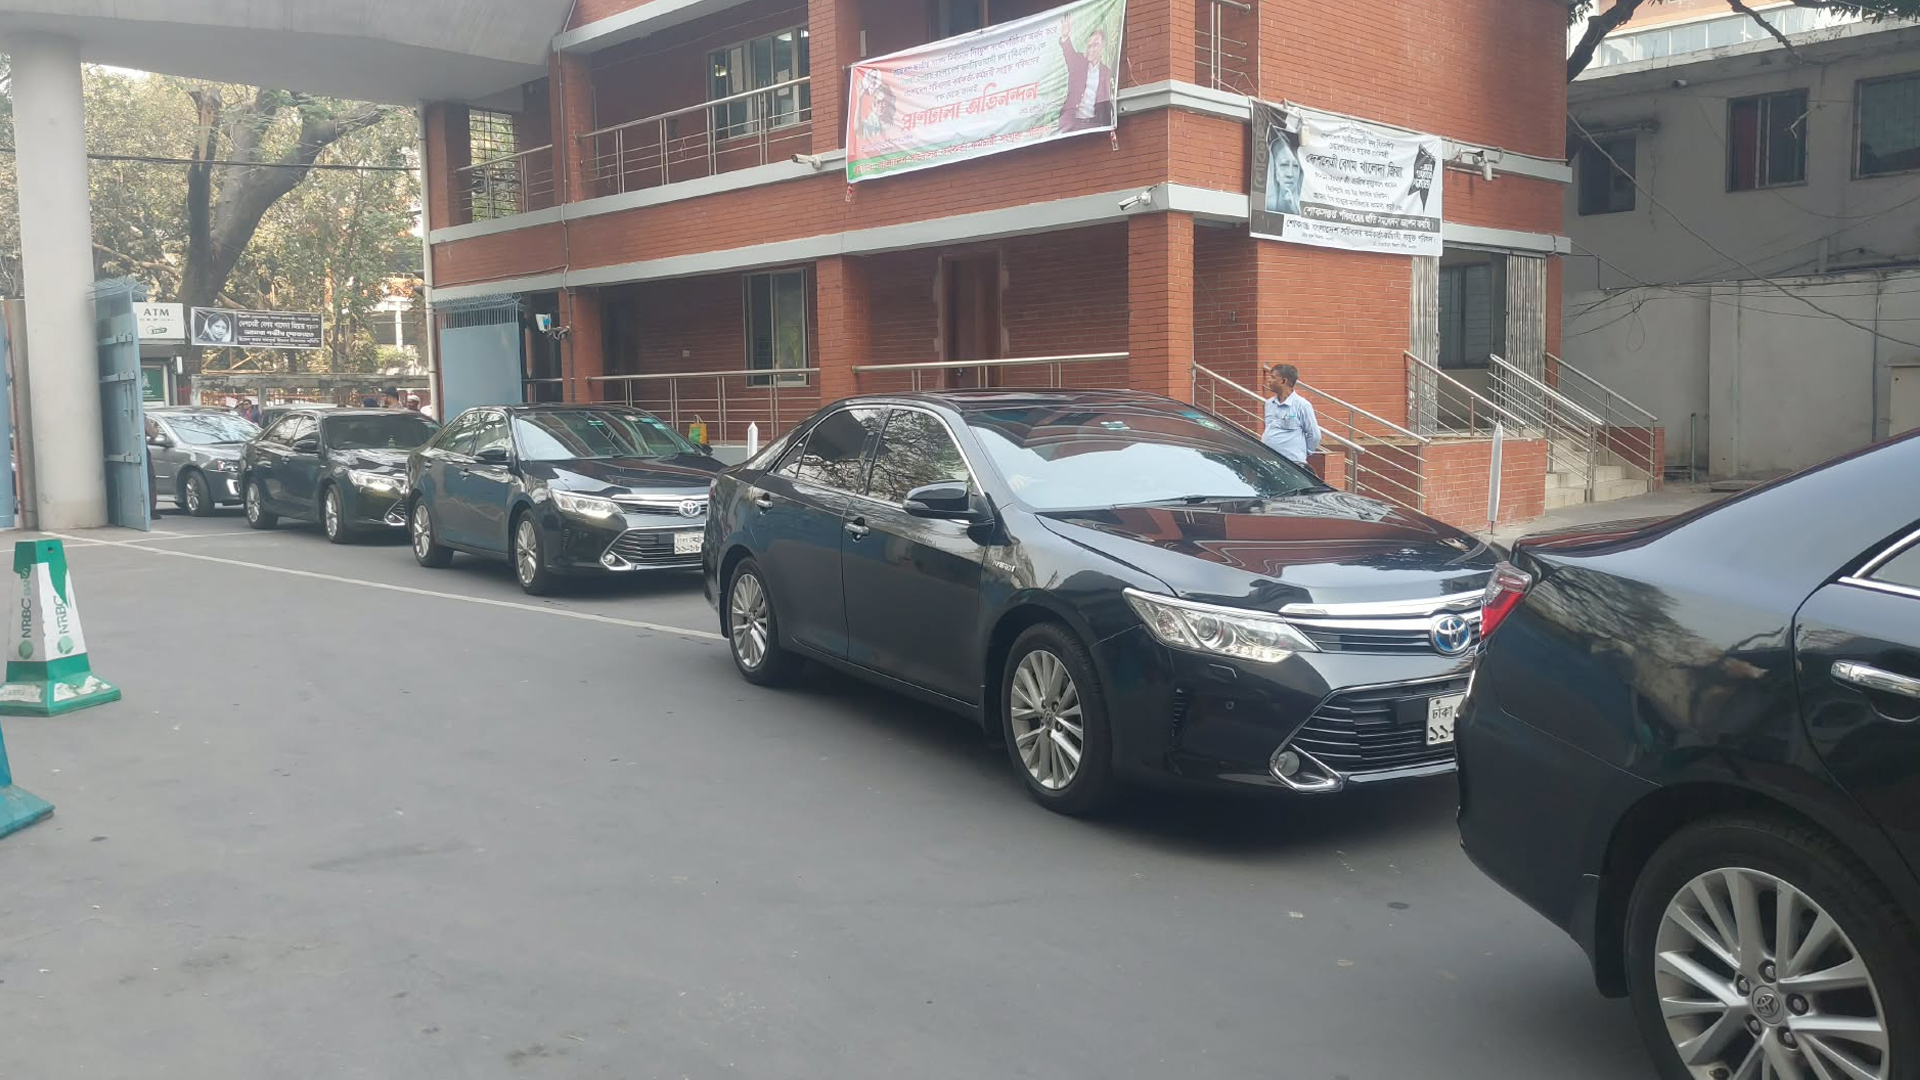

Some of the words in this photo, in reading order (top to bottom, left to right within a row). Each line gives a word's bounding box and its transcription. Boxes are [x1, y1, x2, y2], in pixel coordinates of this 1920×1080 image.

[901, 101, 961, 132] প্রাণঢালা
[966, 82, 1040, 115] অভিনন্দন
[1339, 158, 1358, 173] বেগম
[1359, 161, 1386, 178] খালেদা
[143, 308, 169, 317] ATM
[21, 598, 32, 639] NRBC
[53, 595, 70, 635] NRBC
[1432, 705, 1454, 719] ঢাকা
